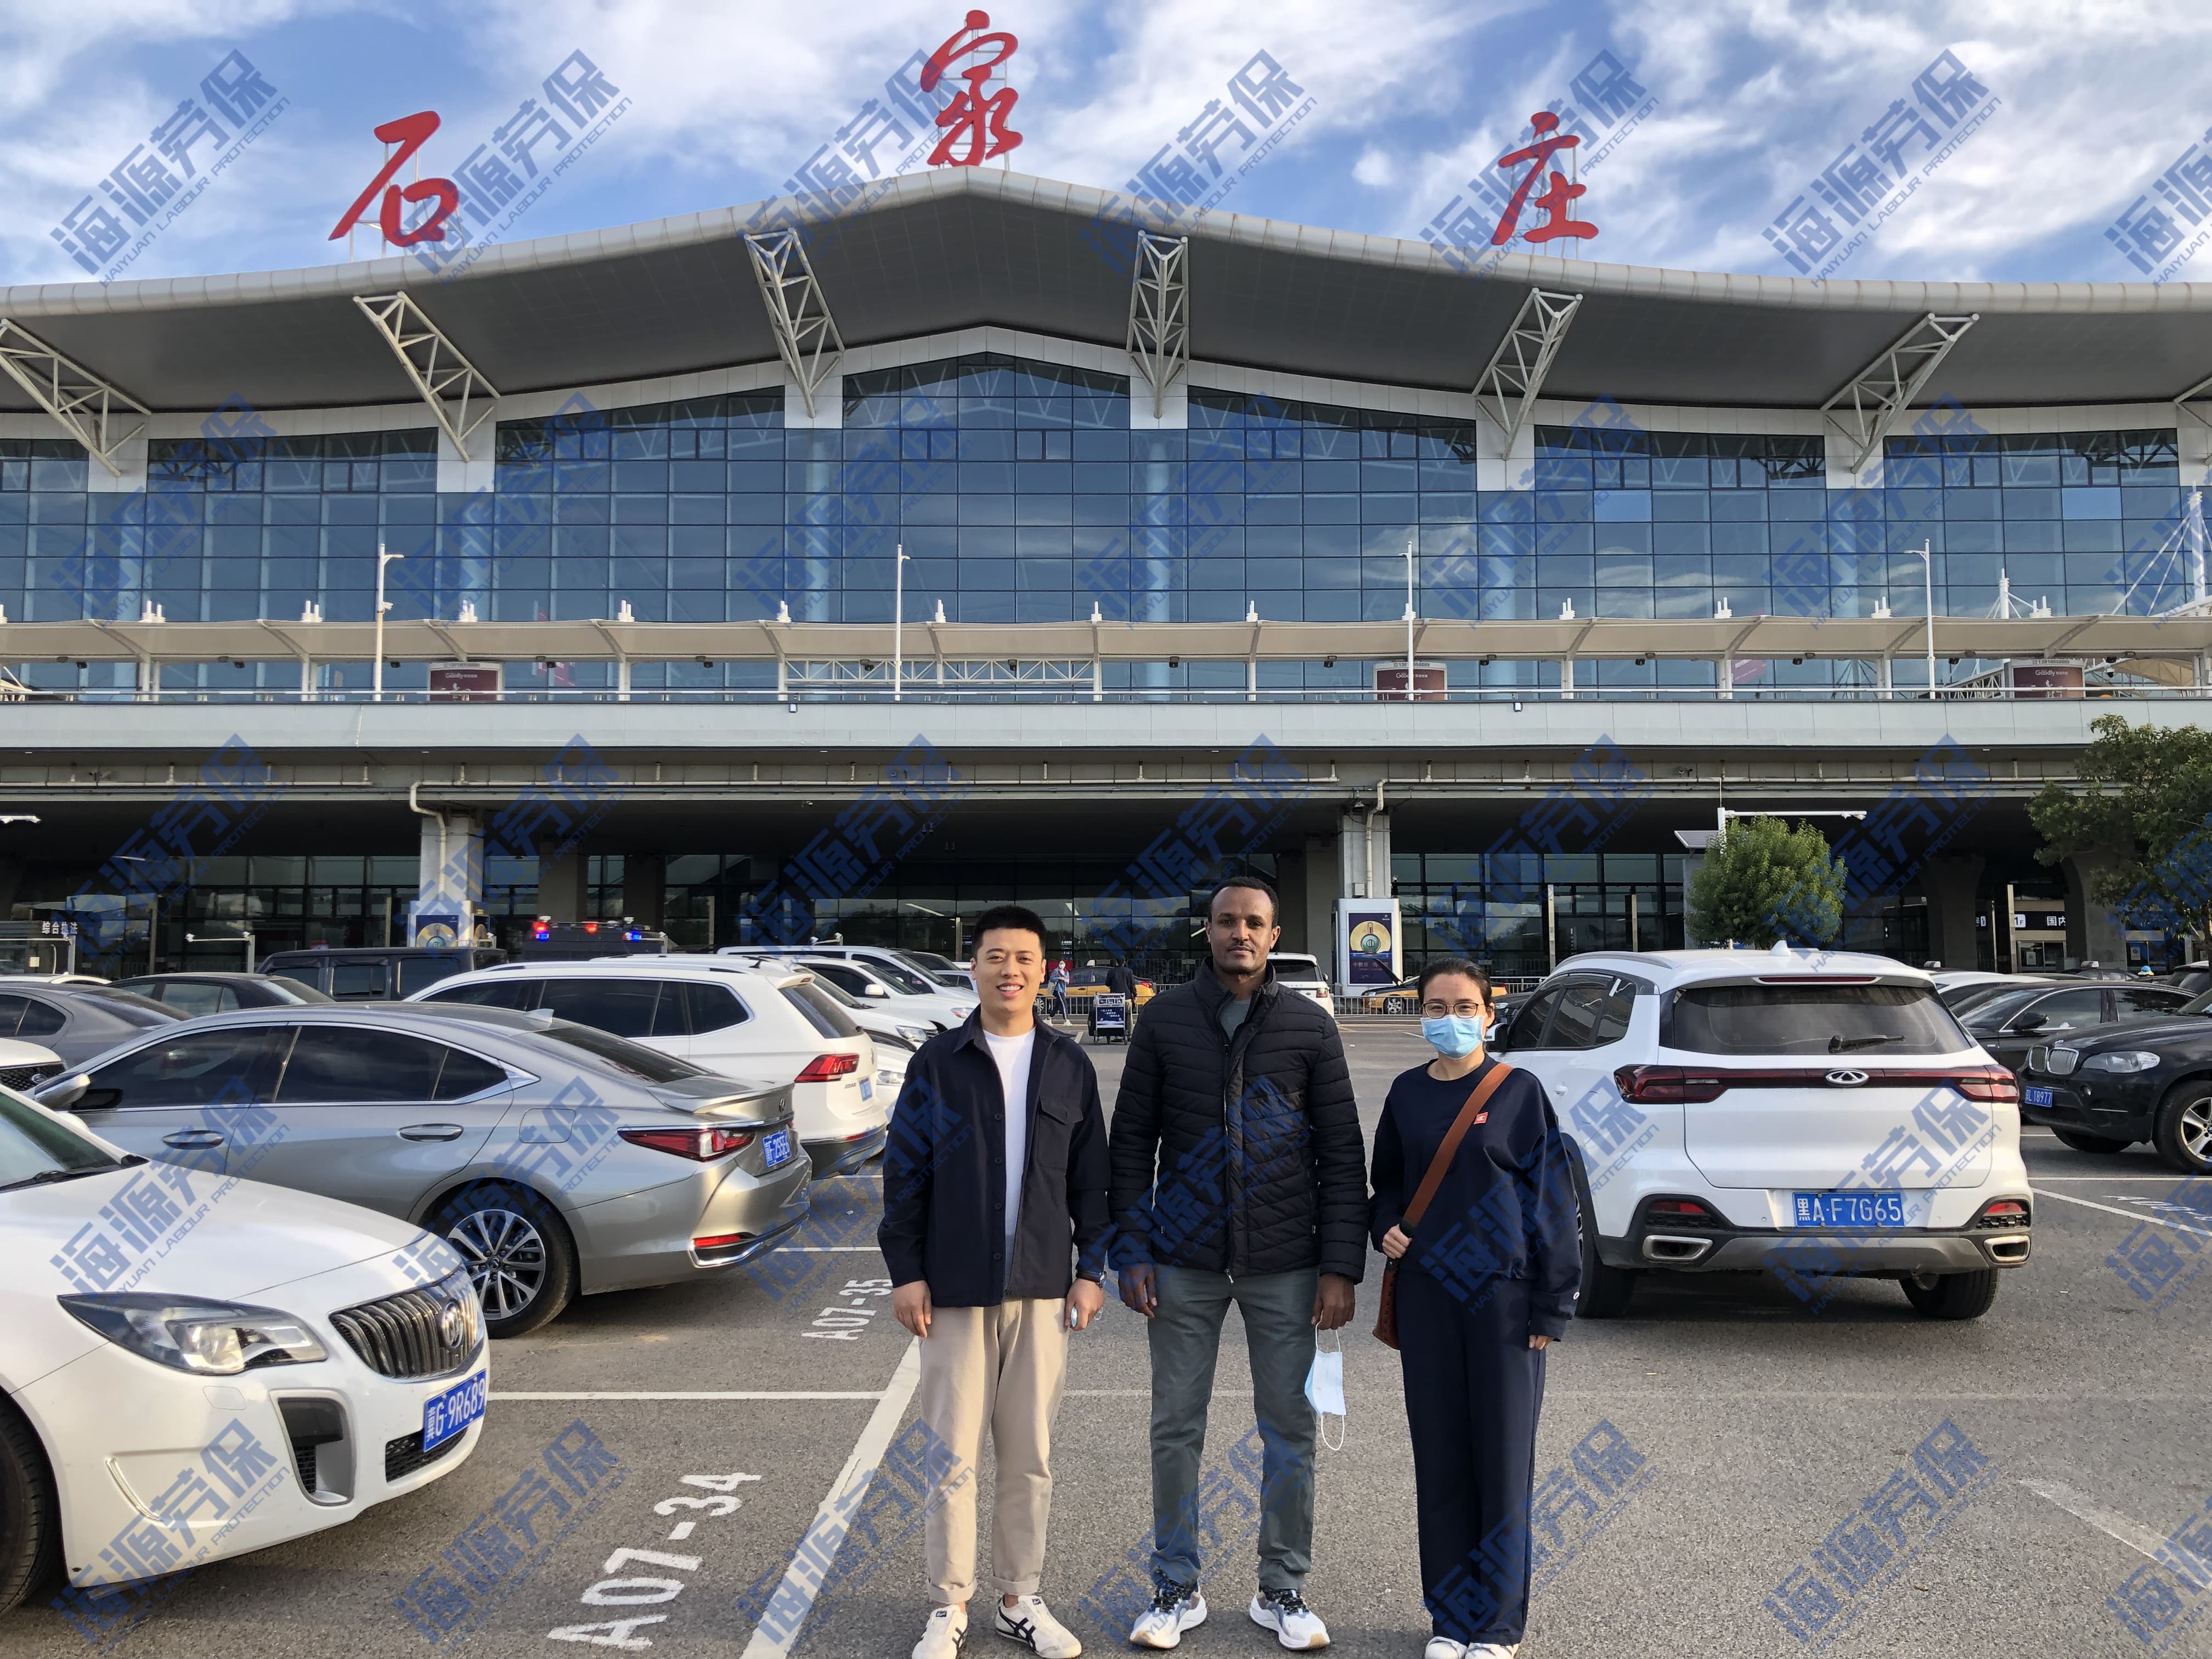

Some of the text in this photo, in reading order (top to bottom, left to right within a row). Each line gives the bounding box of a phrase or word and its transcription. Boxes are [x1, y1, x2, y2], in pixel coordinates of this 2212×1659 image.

[328, 10, 1599, 247] 石 家 庄
[42, 921, 78, 934] 综合执法
[1797, 1198, 1901, 1222] 黑A·F7G65
[802, 1278, 893, 1340] A07-35
[546, 1472, 761, 1651] A07-34
